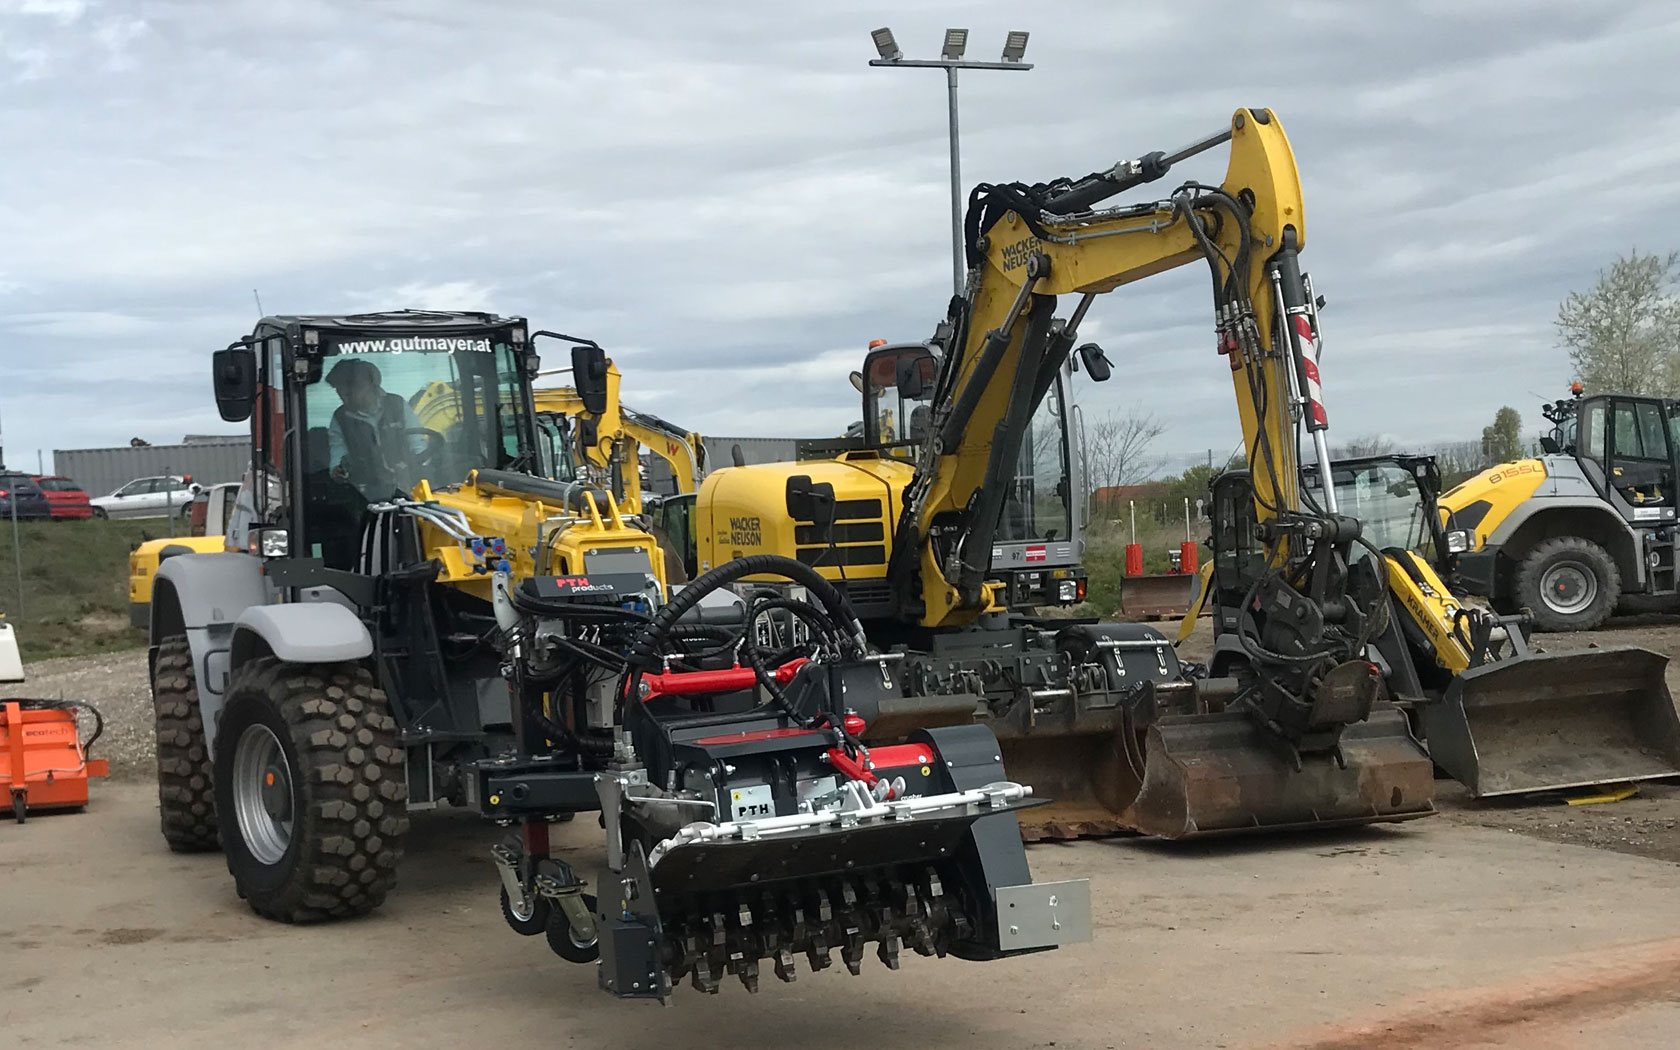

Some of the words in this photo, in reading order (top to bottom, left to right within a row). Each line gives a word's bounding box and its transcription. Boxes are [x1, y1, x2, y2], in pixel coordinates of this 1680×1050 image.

[338, 335, 492, 355] www.gutmayer.at
[1489, 464, 1543, 484] 8155L
[730, 517, 761, 531] WACKER
[731, 531, 762, 547] NEUSON
[556, 577, 590, 588] PTH
[571, 584, 614, 593] products
[1407, 594, 1439, 642] KRAMER
[738, 804, 769, 817] PTH
